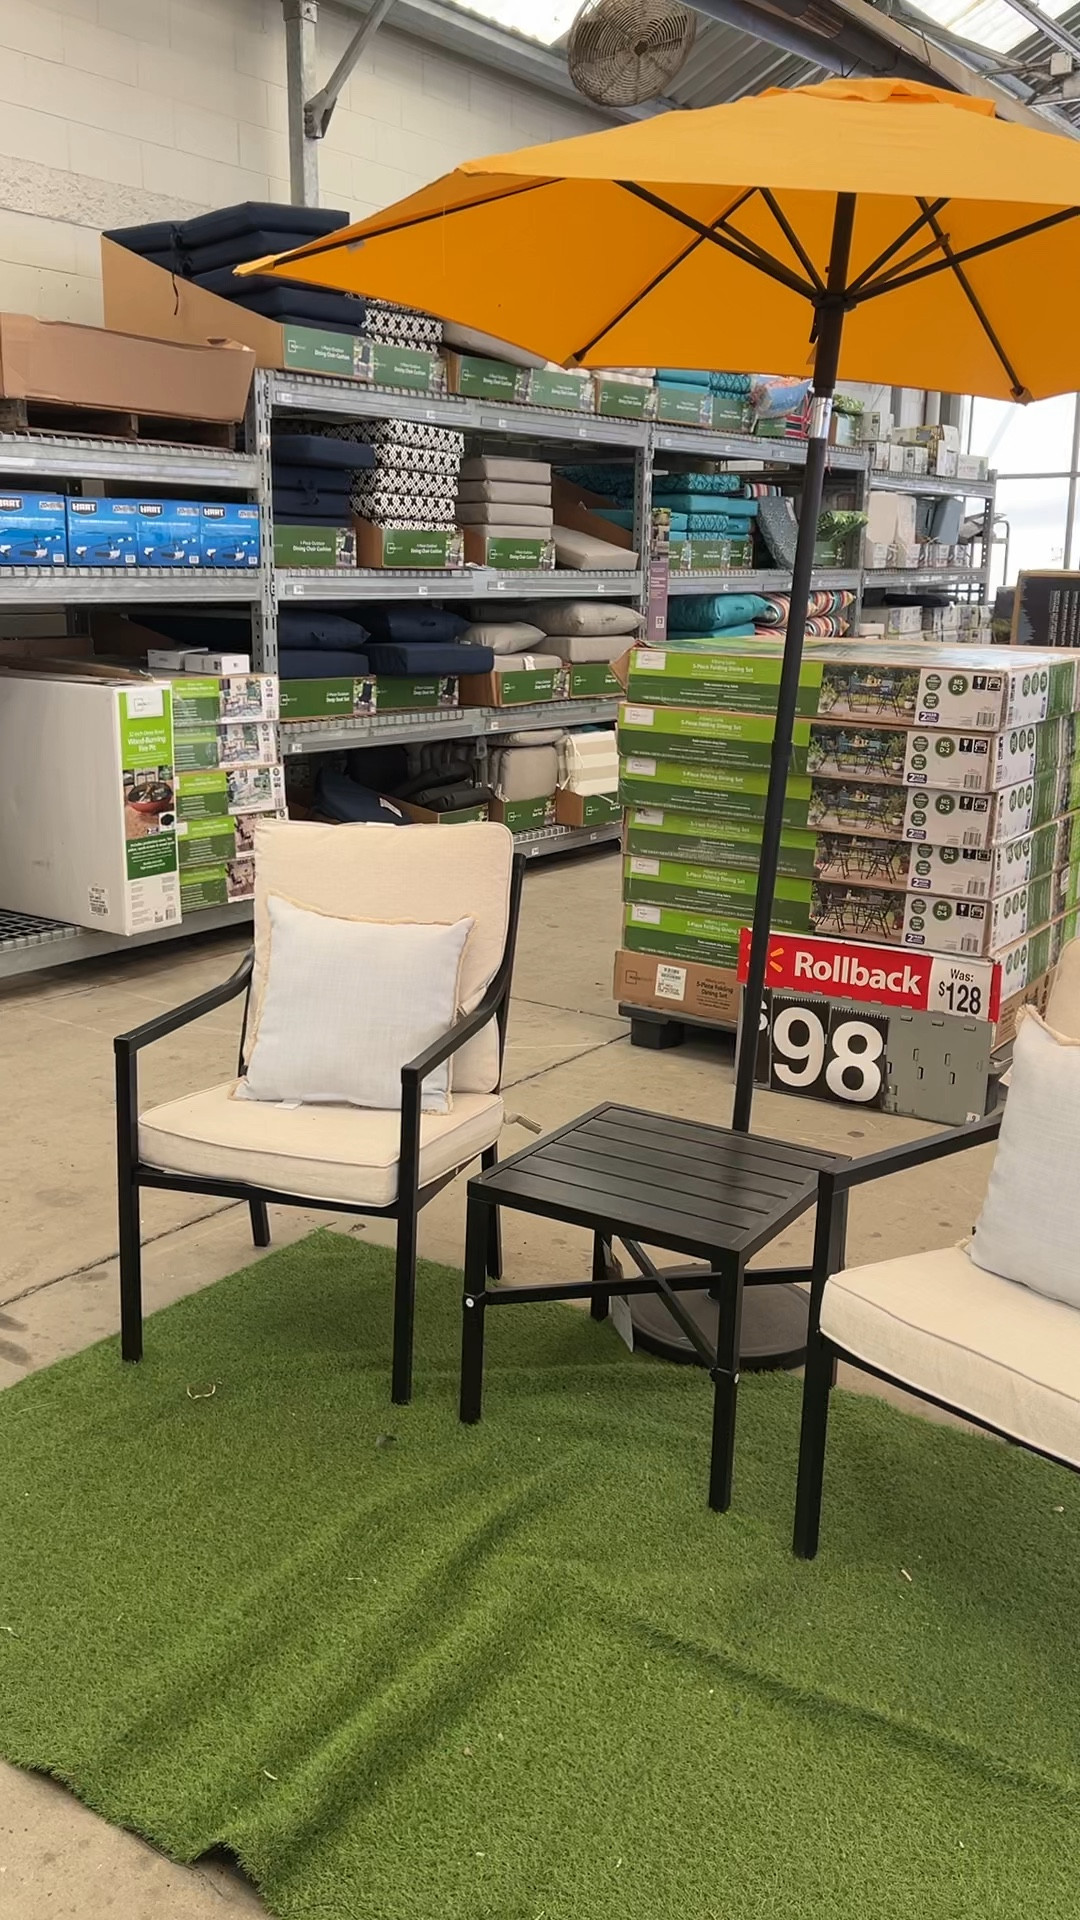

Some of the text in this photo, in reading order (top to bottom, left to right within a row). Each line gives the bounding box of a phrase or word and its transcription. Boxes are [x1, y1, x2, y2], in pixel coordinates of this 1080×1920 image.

[710, 664, 728, 672] Folding
[794, 951, 922, 995] Rollback
[951, 968, 974, 983] Was:
[938, 980, 981, 1015] $128
